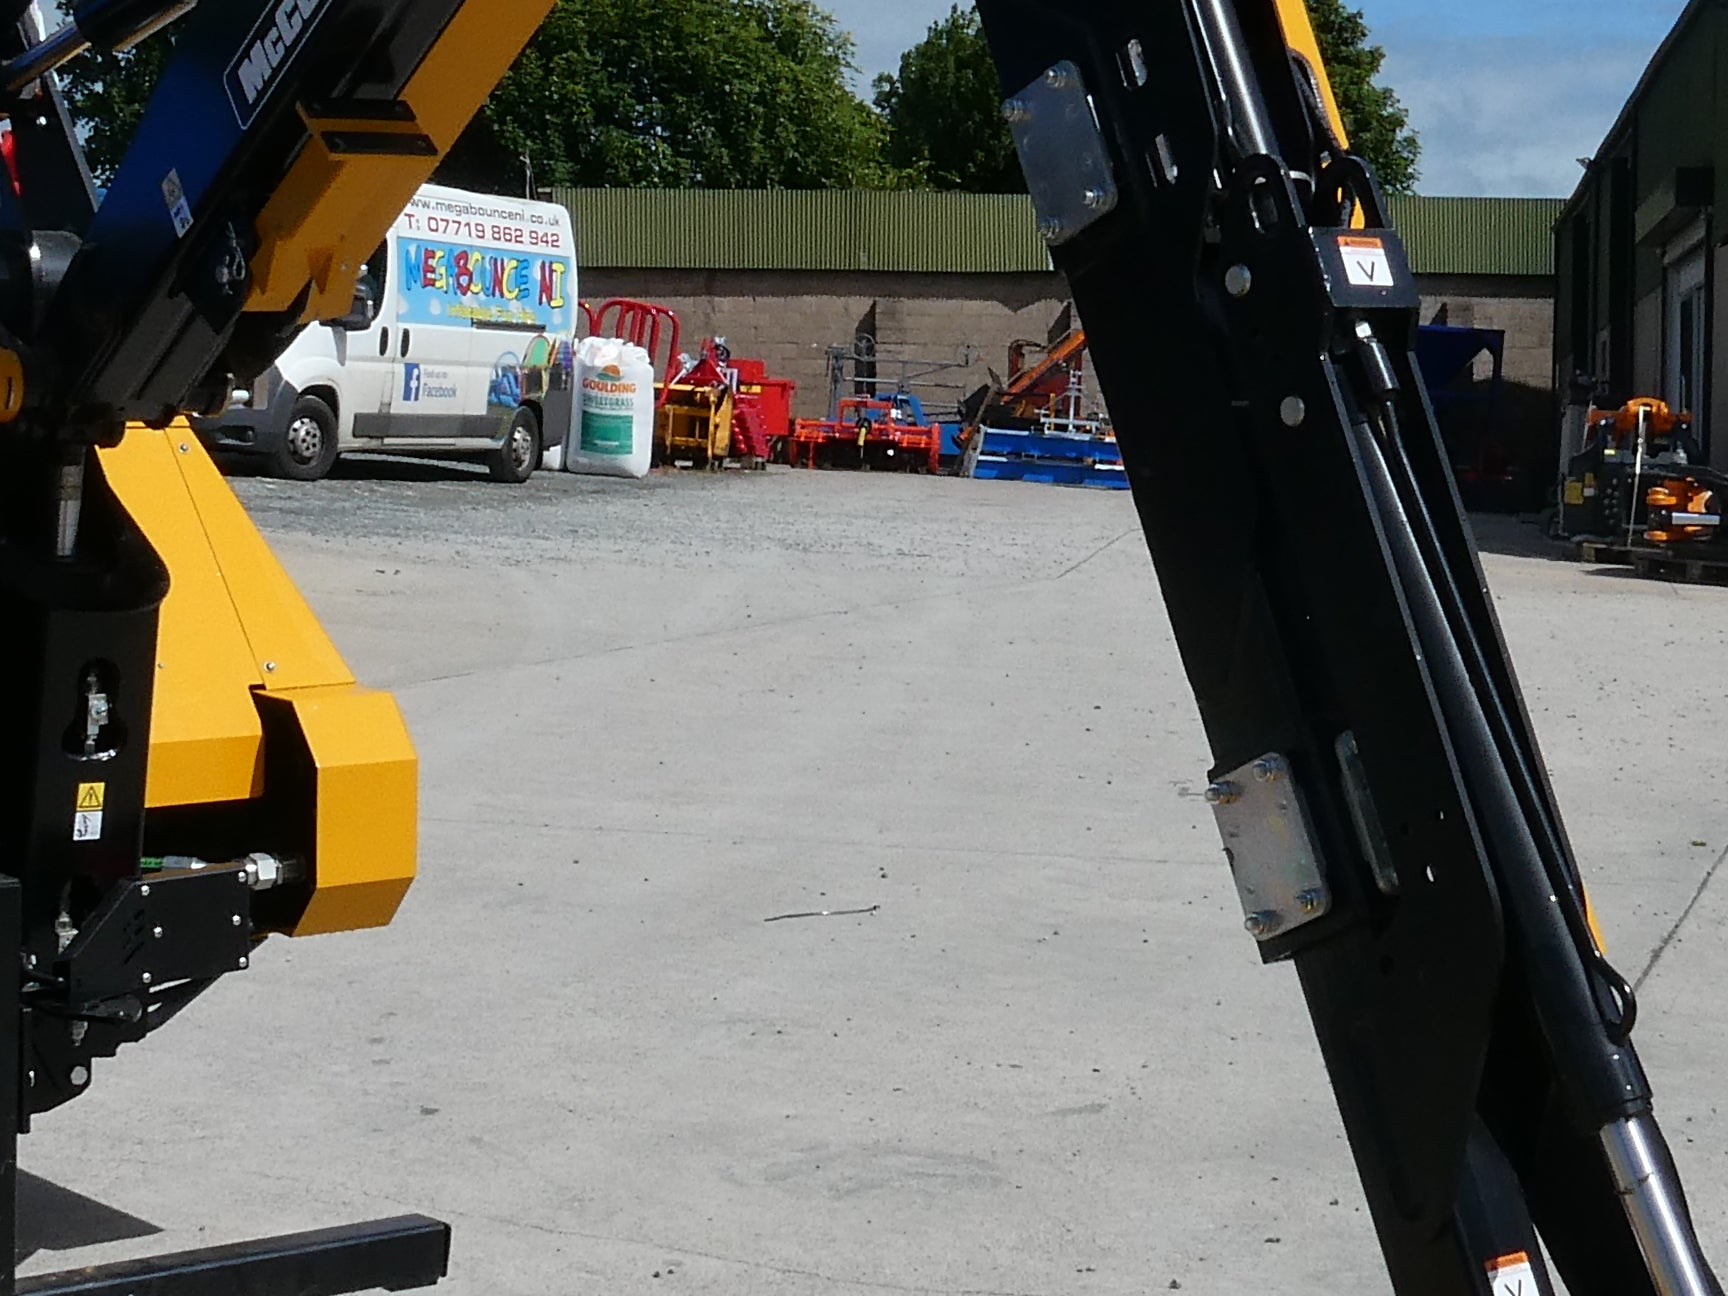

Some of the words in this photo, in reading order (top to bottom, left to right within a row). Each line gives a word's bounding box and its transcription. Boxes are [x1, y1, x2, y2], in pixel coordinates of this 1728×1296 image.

[404, 213, 420, 230] T:
[427, 216, 486, 239] 07719
[491, 224, 524, 244] 862
[529, 229, 560, 248] 942
[405, 245, 530, 301] MEGABOUNCE
[539, 260, 566, 309] NI
[582, 377, 637, 393] GOULDING
